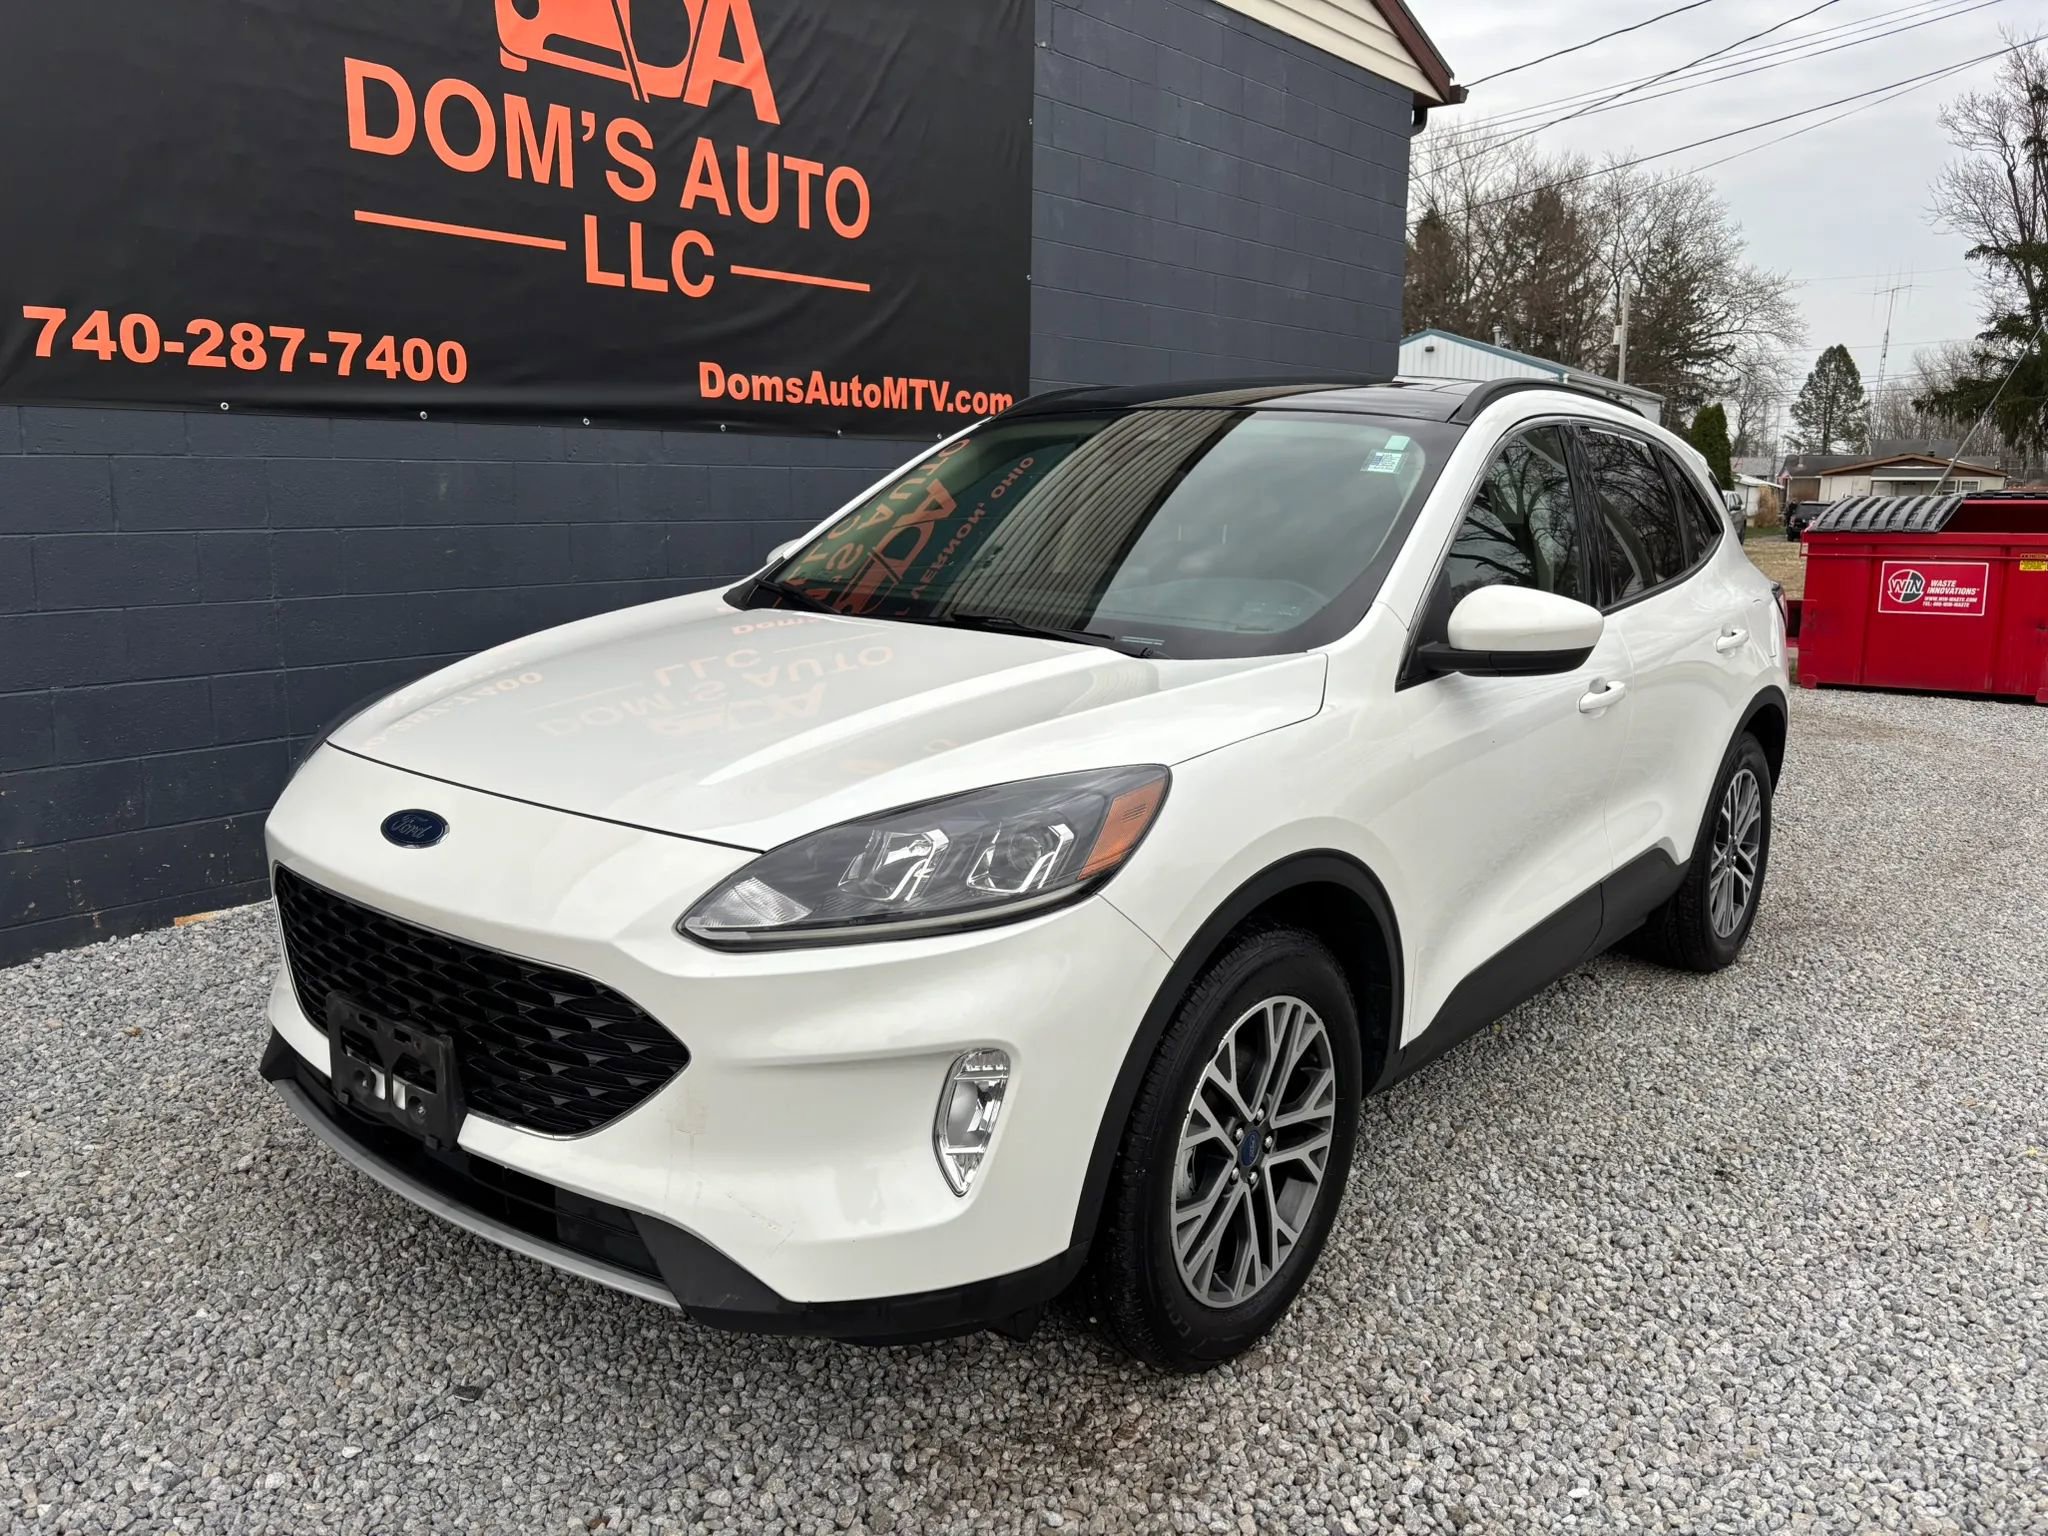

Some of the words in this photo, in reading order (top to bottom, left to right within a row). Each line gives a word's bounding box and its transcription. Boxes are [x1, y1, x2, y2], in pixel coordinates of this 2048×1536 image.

[345, 58, 656, 201] DOM'S
[681, 138, 869, 238] AUTO
[585, 215, 714, 297] LLC
[24, 306, 467, 383] 740-287-7400
[700, 362, 1012, 414] DomsAutoMTV.com
[1889, 578, 1923, 594] WIN
[1926, 587, 1976, 596] INNOVATIONS
[1930, 579, 1957, 588] WASTE
